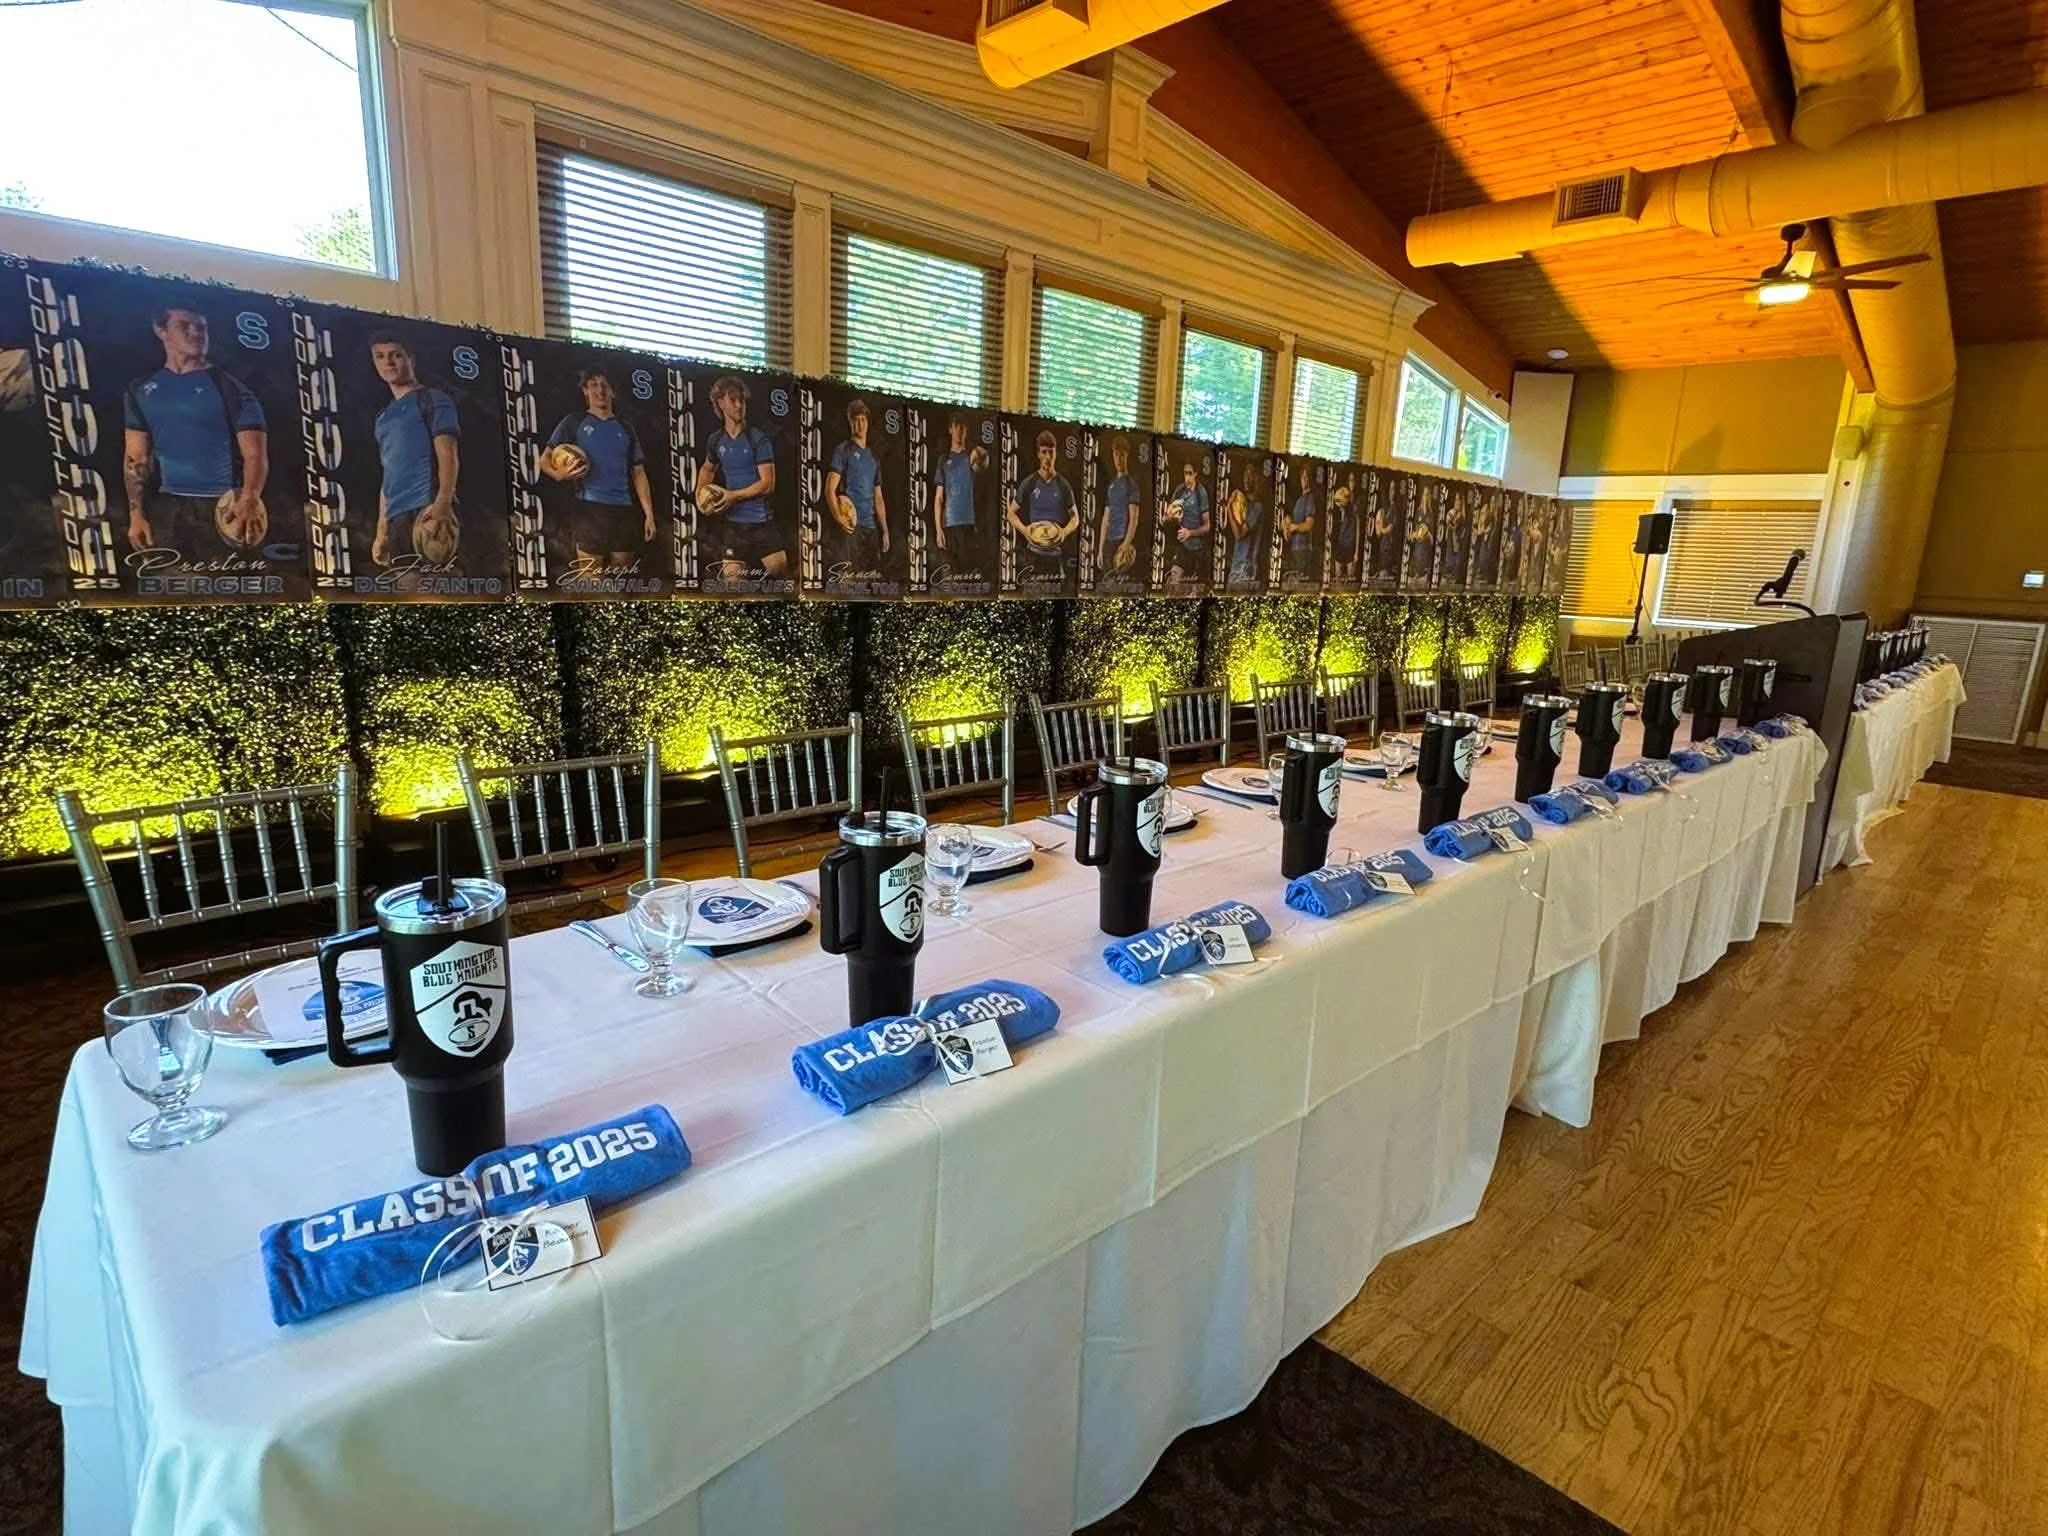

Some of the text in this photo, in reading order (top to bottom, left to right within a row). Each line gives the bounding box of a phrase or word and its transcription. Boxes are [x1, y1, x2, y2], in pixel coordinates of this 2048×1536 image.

[236, 311, 270, 350] S
[452, 345, 480, 380] S
[631, 369, 653, 400] S
[770, 388, 789, 417] S
[25, 273, 82, 573] SOUTHINGTON
[41, 276, 119, 577] RUGBY
[885, 409, 900, 434] S
[981, 420, 994, 444] S
[291, 311, 326, 573] SOUTHINGTON
[304, 314, 351, 576] RUGBY
[1065, 435, 1078, 459] S
[500, 345, 528, 577] SOUTHINGTON
[511, 348, 546, 578] RUGBY
[124, 547, 267, 579] Preston
[375, 553, 457, 585] Jack
[556, 557, 641, 586] Joseph
[0, 578, 43, 598] IN
[73, 578, 121, 589] 25
[138, 576, 285, 595] BERGER
[316, 576, 353, 588] 25
[417, 577, 502, 594] SANTO
[519, 578, 549, 589] 25
[675, 579, 699, 588] 25
[803, 581, 823, 589] 25
[910, 583, 928, 591] 25
[422, 958, 498, 988] BLUE KNIGHTS
[423, 948, 496, 976] SOUTHINGTON
[958, 992, 1027, 1022] 2025
[467, 1024, 476, 1039] S
[547, 1121, 659, 1184] 2025
